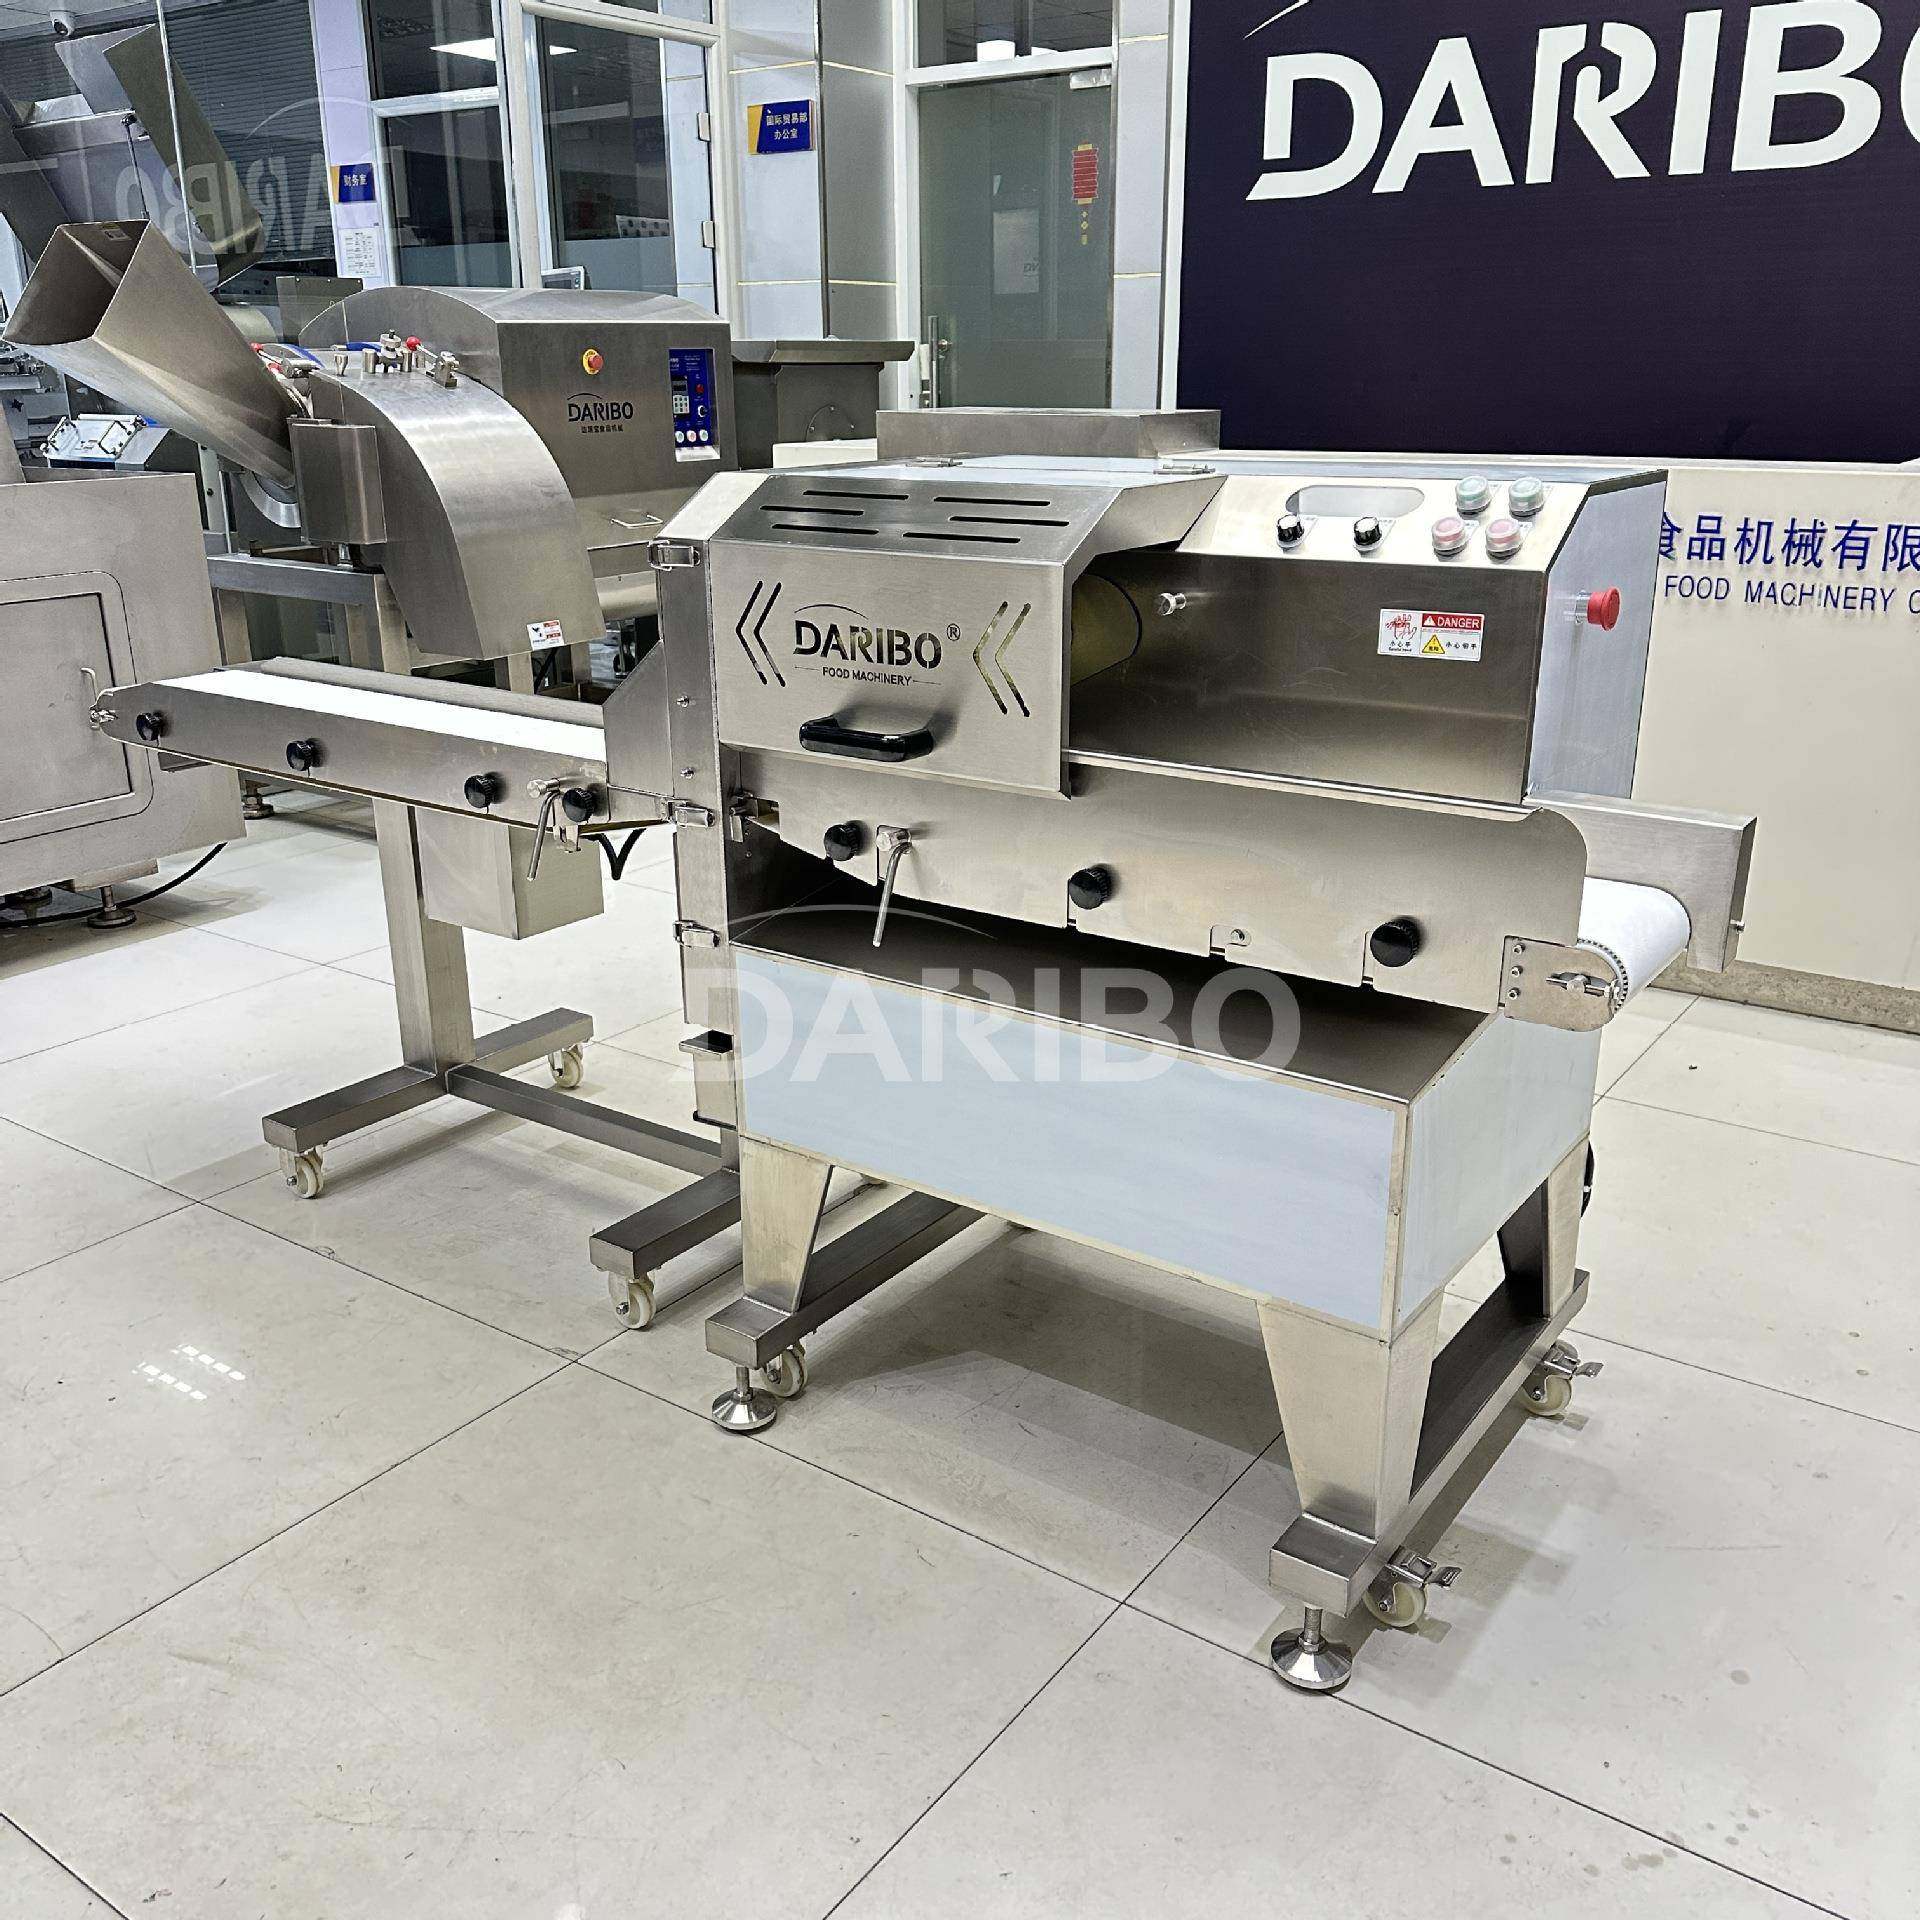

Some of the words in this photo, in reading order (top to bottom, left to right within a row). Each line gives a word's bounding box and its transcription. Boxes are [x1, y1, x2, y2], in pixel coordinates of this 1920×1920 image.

[1246, 0, 1920, 201] DARIB
[766, 112, 808, 127] 国际贸易部
[774, 128, 798, 140] 办公室
[343, 174, 368, 187] 财务室
[568, 401, 634, 422] DARIBO
[1664, 575, 1731, 601] FOOD
[1744, 580, 1897, 612] MACHINERY
[1437, 616, 1480, 629] DANGER
[793, 619, 942, 670] DARIBO
[822, 666, 850, 680] FOOD
[852, 669, 912, 687] MACHINERY
